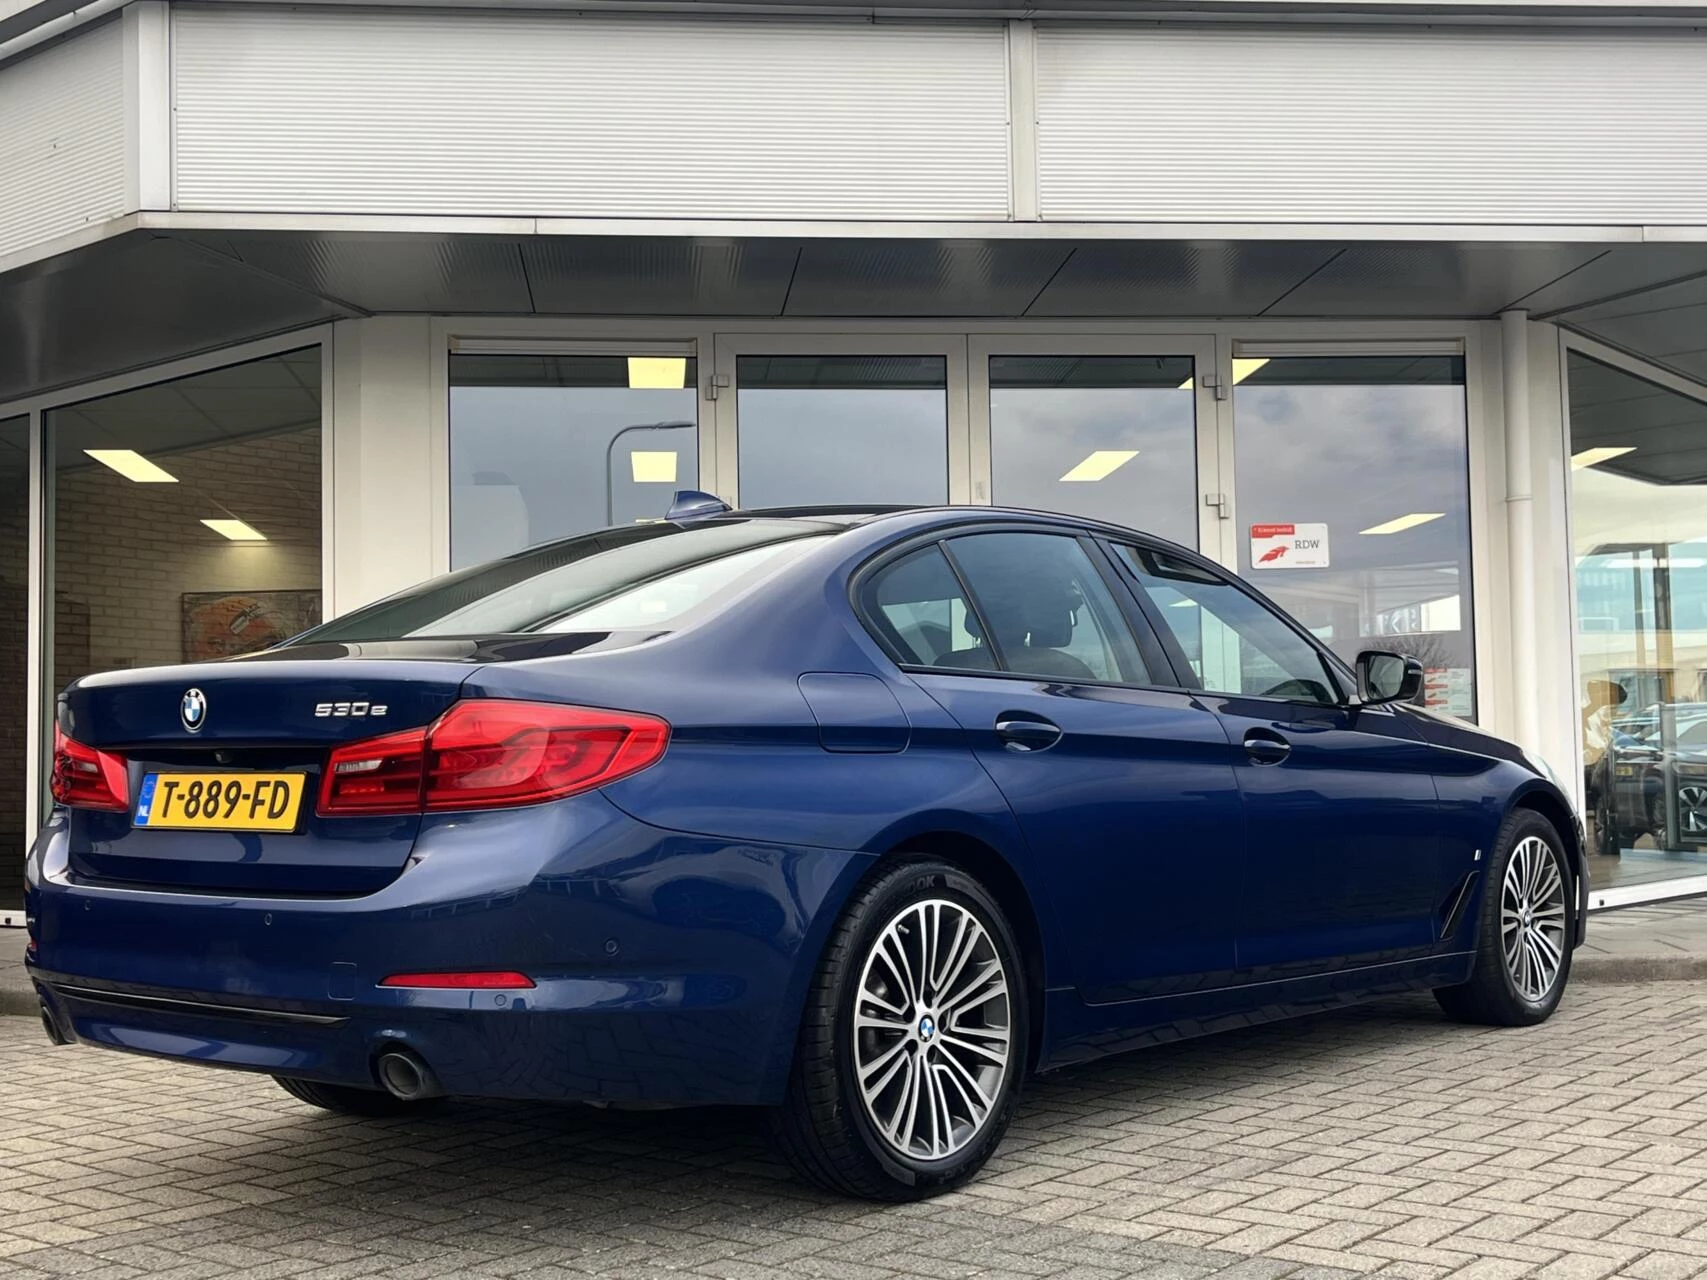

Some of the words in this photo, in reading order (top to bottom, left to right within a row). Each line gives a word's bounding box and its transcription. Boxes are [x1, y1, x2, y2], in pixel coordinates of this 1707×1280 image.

[1295, 539, 1320, 550] RDW
[314, 701, 389, 718] 530e
[162, 779, 291, 820] T-889-FD
[138, 804, 150, 817] NL
